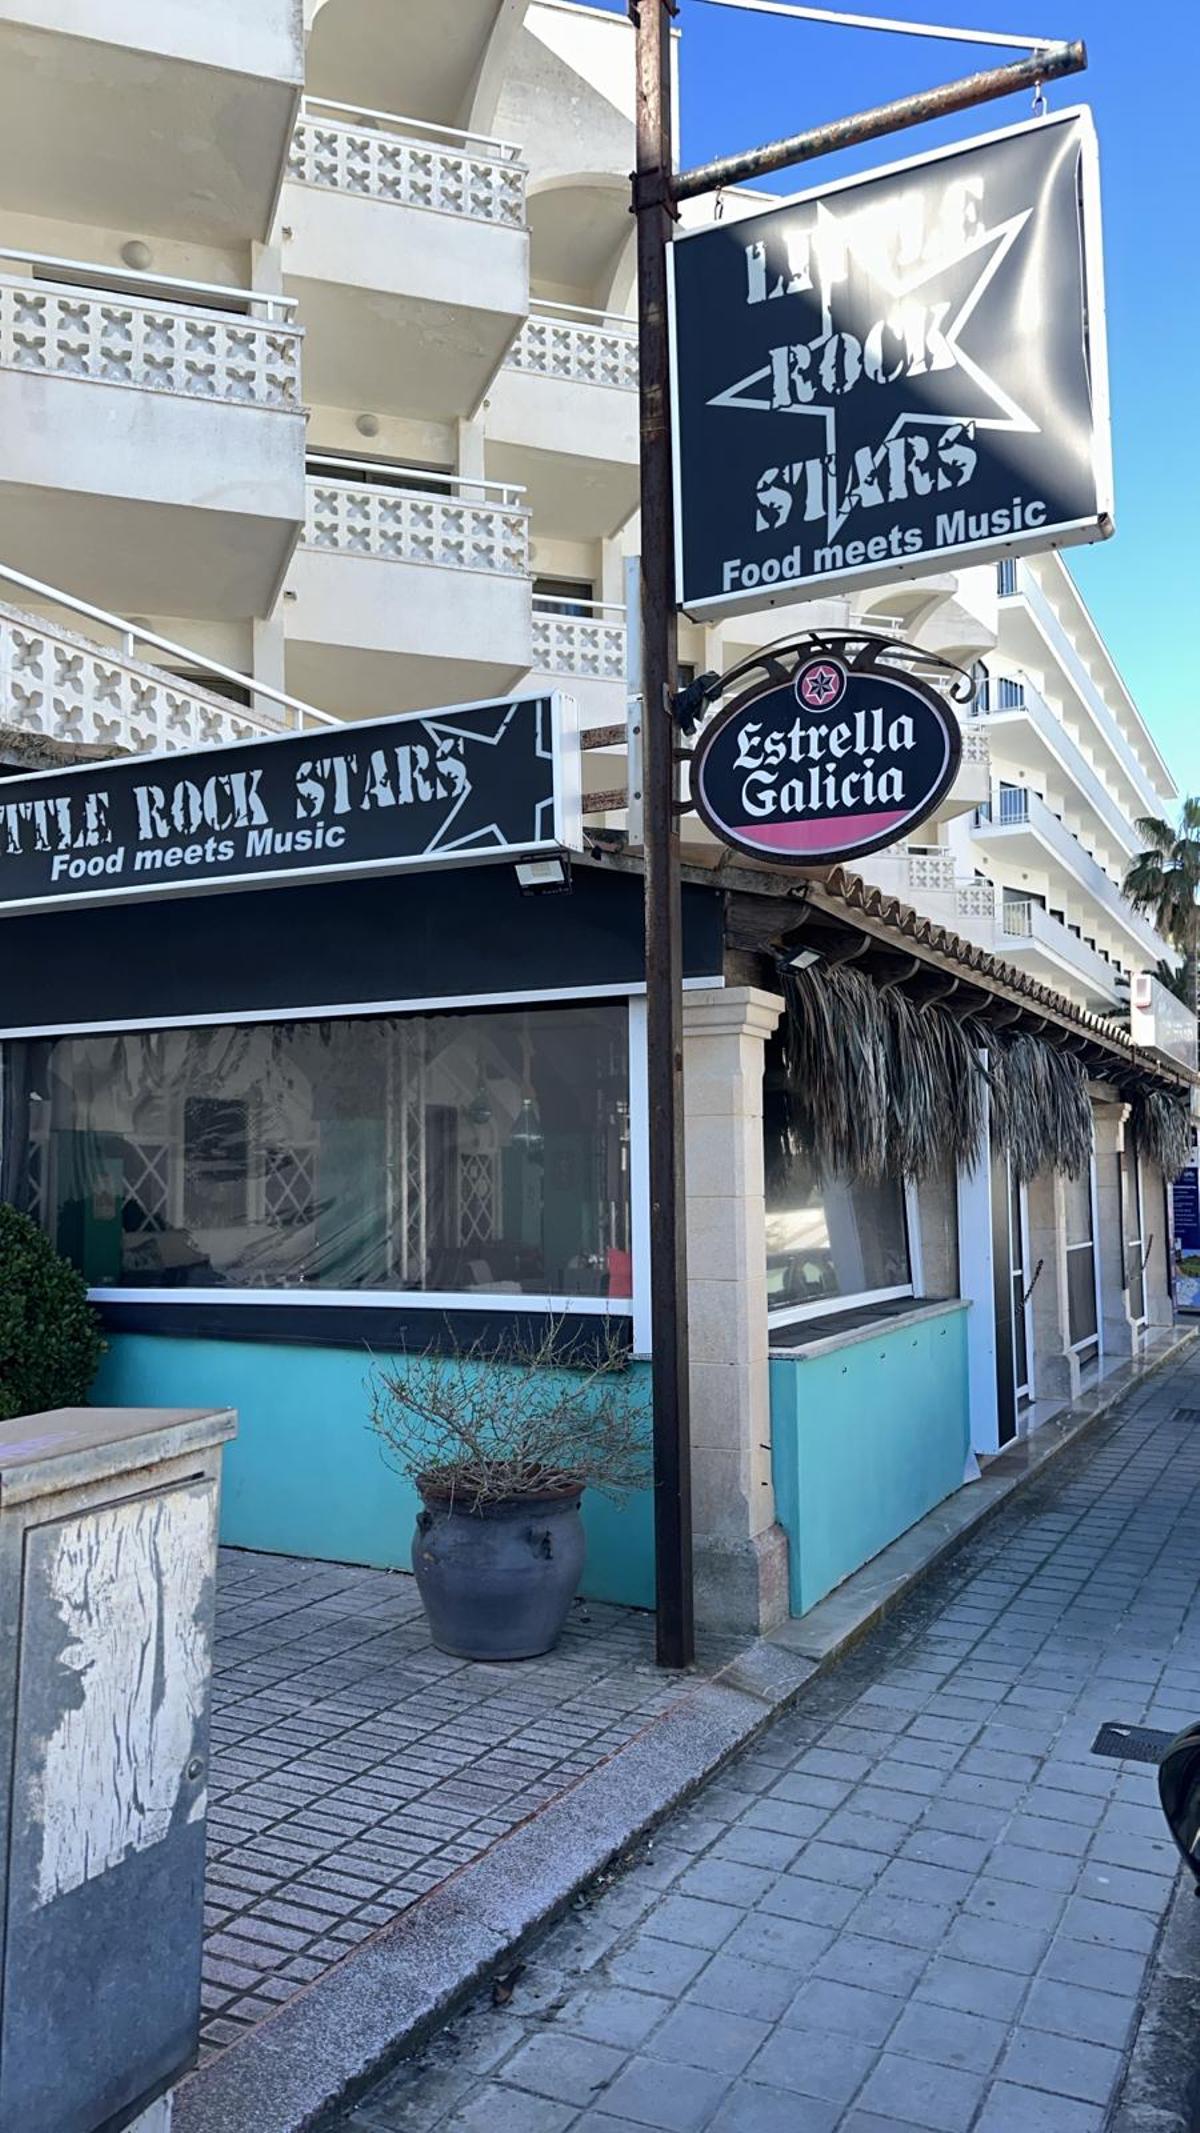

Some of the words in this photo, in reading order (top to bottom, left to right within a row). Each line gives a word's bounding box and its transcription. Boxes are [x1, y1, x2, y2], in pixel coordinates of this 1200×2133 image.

[744, 176, 985, 305] LITLE
[768, 301, 957, 409] ROCK
[755, 421, 978, 532] STARS
[722, 546, 802, 592] Food
[813, 522, 923, 573] meets
[935, 497, 1048, 546] Music
[133, 768, 269, 842] ROCK
[296, 736, 467, 820] STARS
[733, 707, 917, 771] Estrella
[741, 757, 906, 817] Galicia
[50, 846, 125, 881] Food
[134, 828, 235, 872] meets
[246, 820, 347, 859] Music
